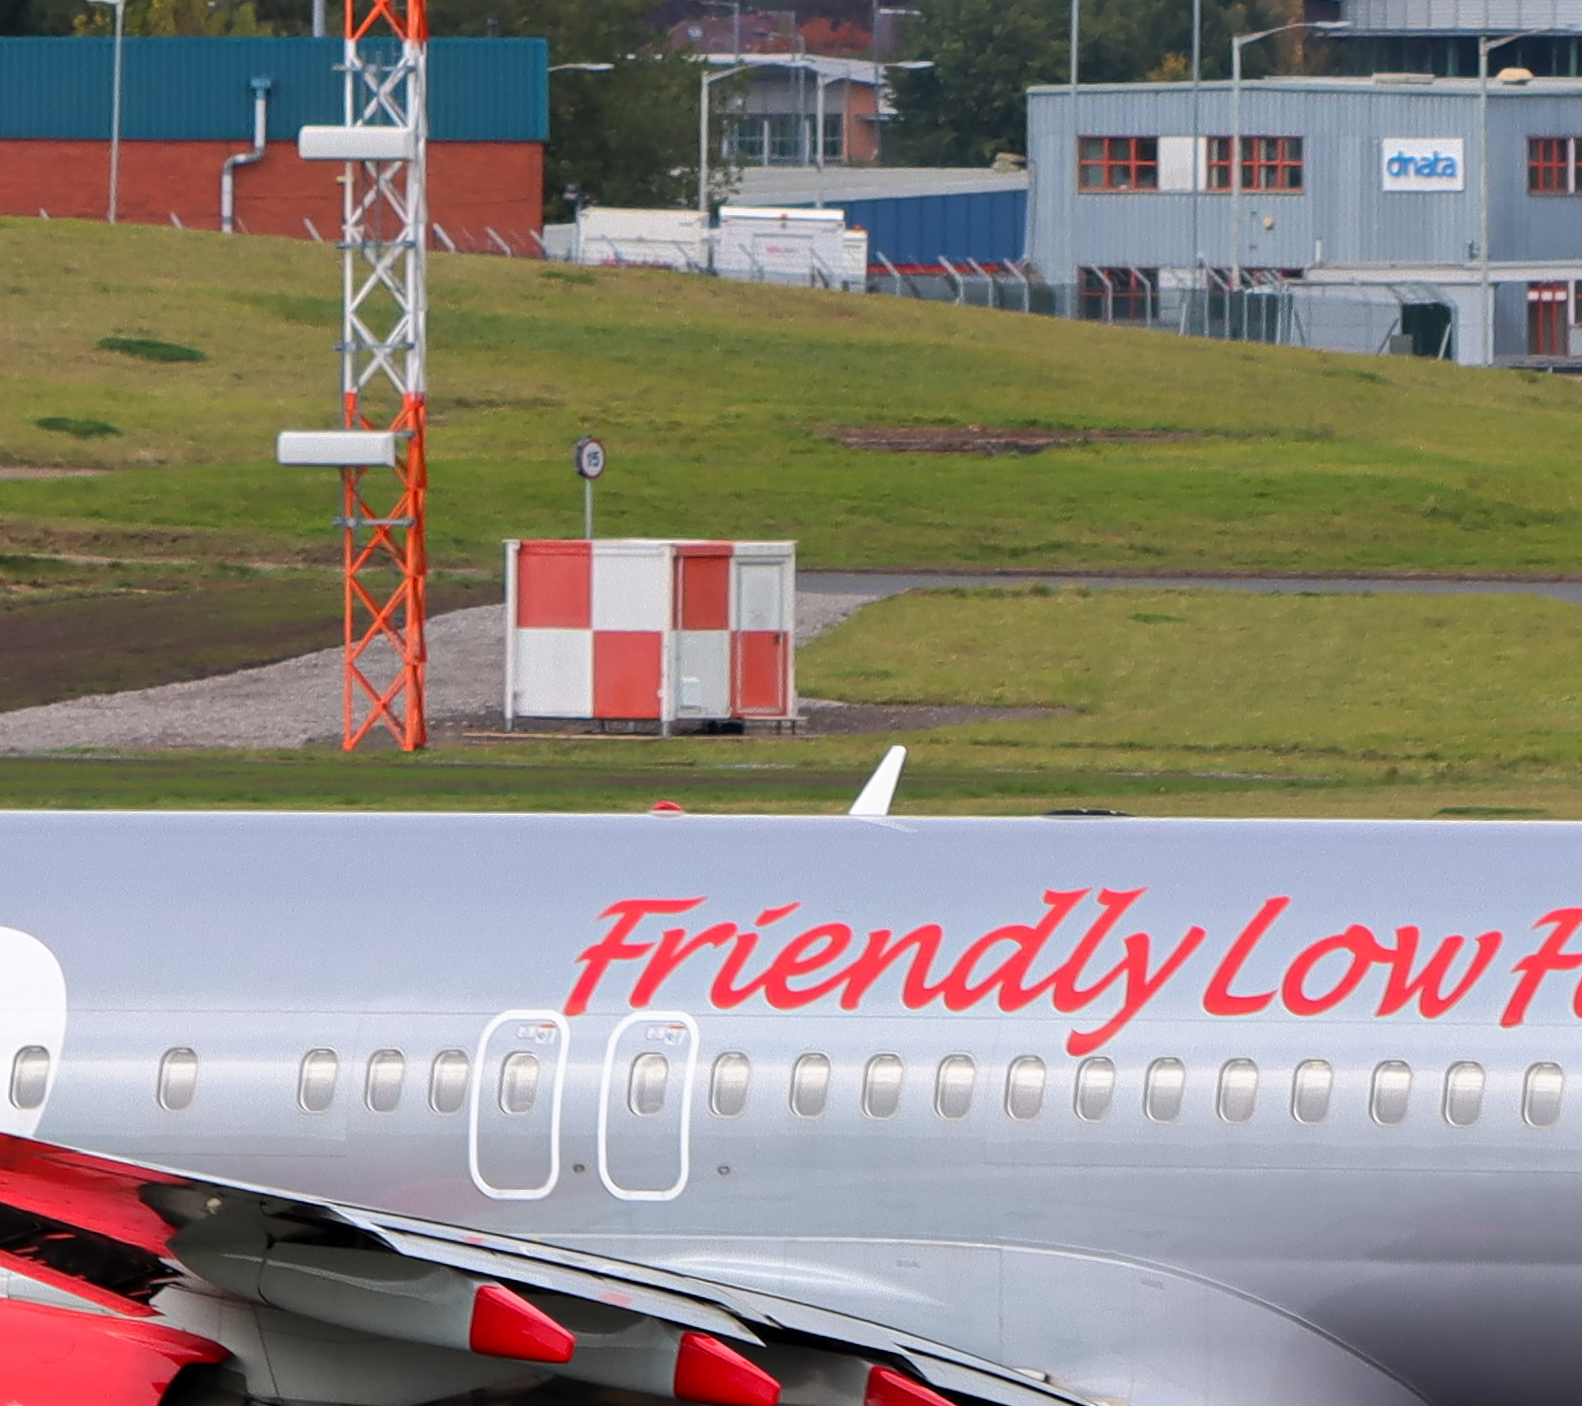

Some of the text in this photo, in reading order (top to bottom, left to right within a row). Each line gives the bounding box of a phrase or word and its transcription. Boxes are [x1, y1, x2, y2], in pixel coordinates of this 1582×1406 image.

[1386, 150, 1456, 177] dnata
[562, 887, 1206, 1057] Friendly
[1201, 896, 1503, 1020] Low
